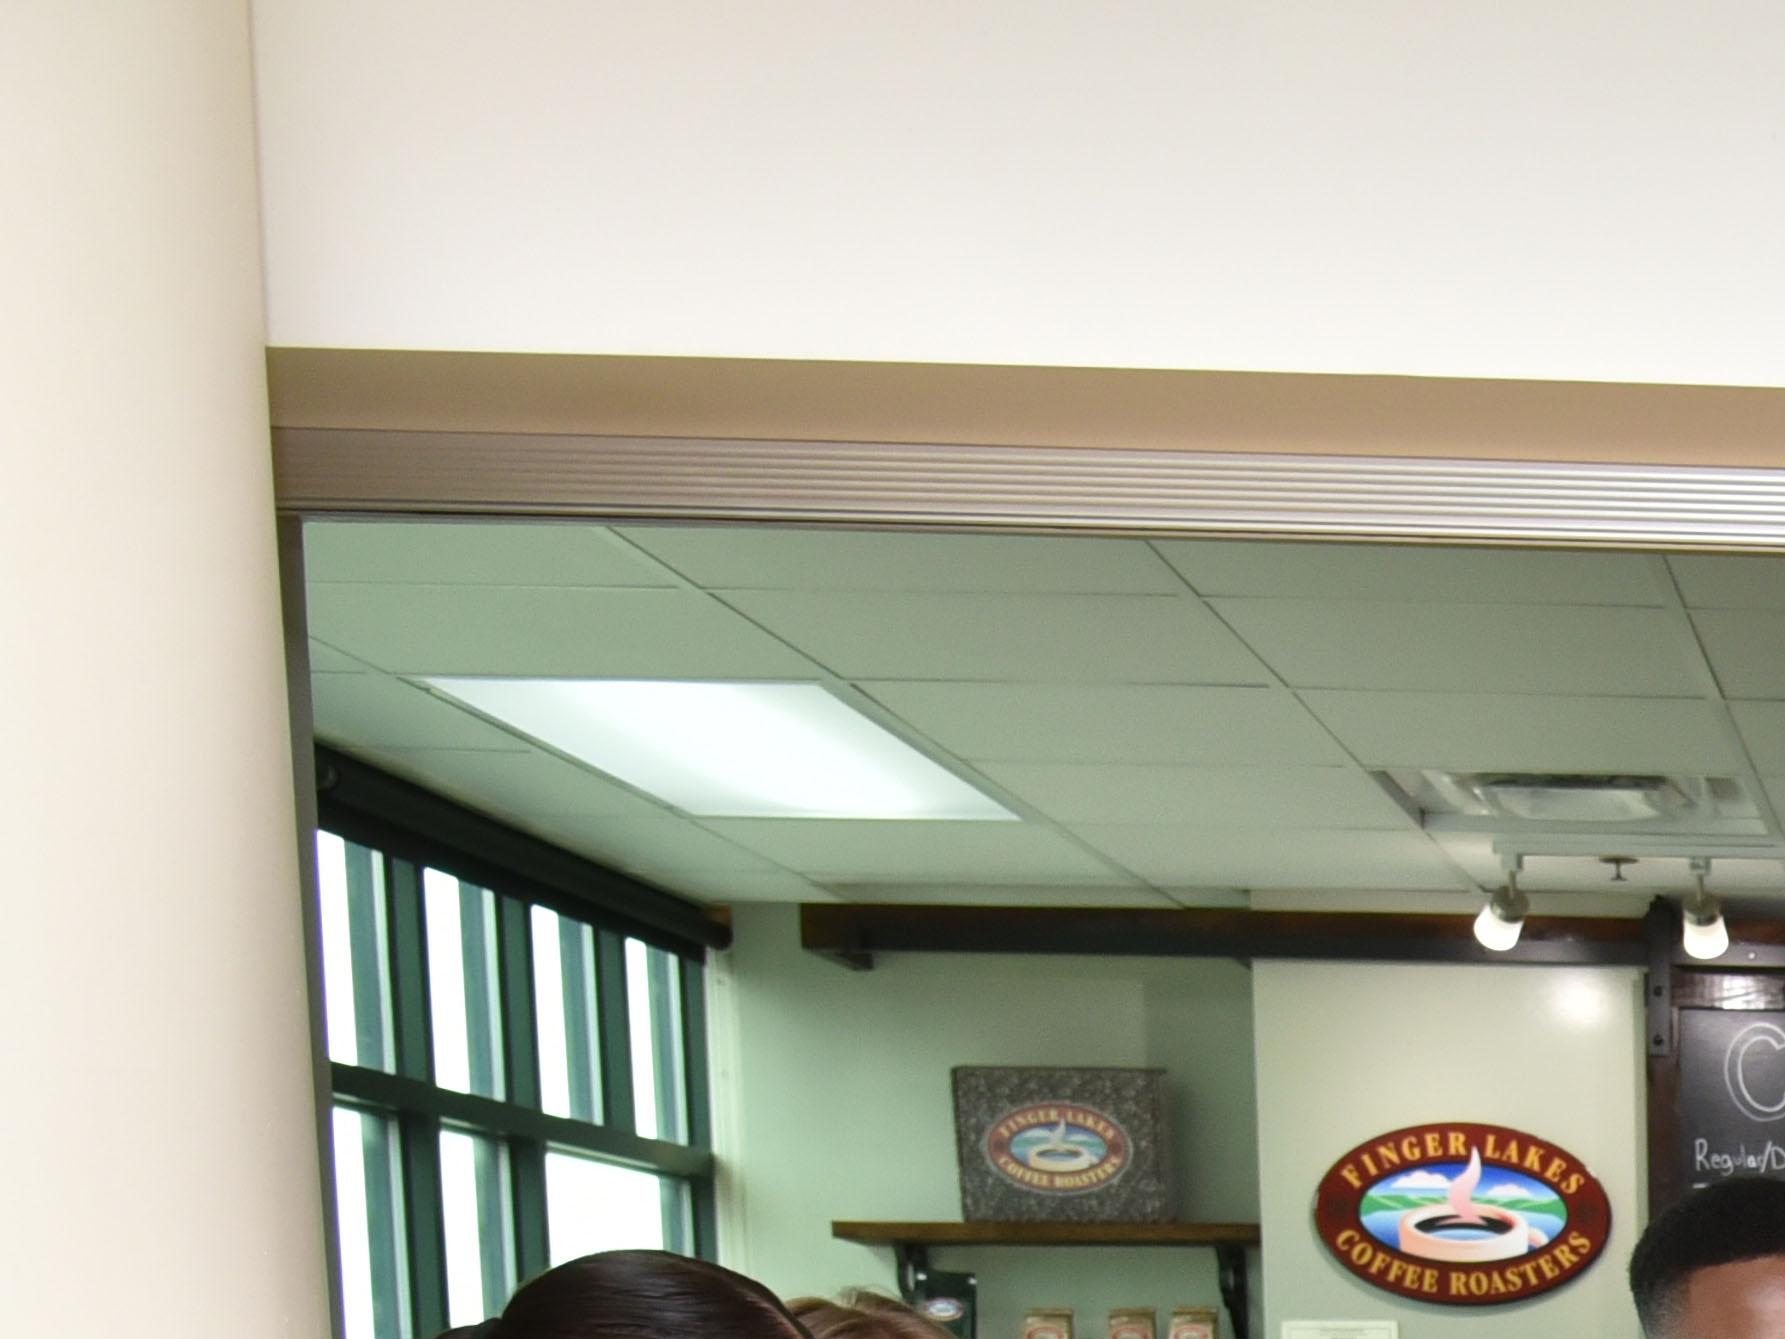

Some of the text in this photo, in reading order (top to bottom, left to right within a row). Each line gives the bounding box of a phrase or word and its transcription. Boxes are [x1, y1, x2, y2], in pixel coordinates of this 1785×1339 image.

[1341, 1131, 1585, 1195] FINGER LAKES
[1336, 1229, 1591, 1297] COFFEE ROASTERS
